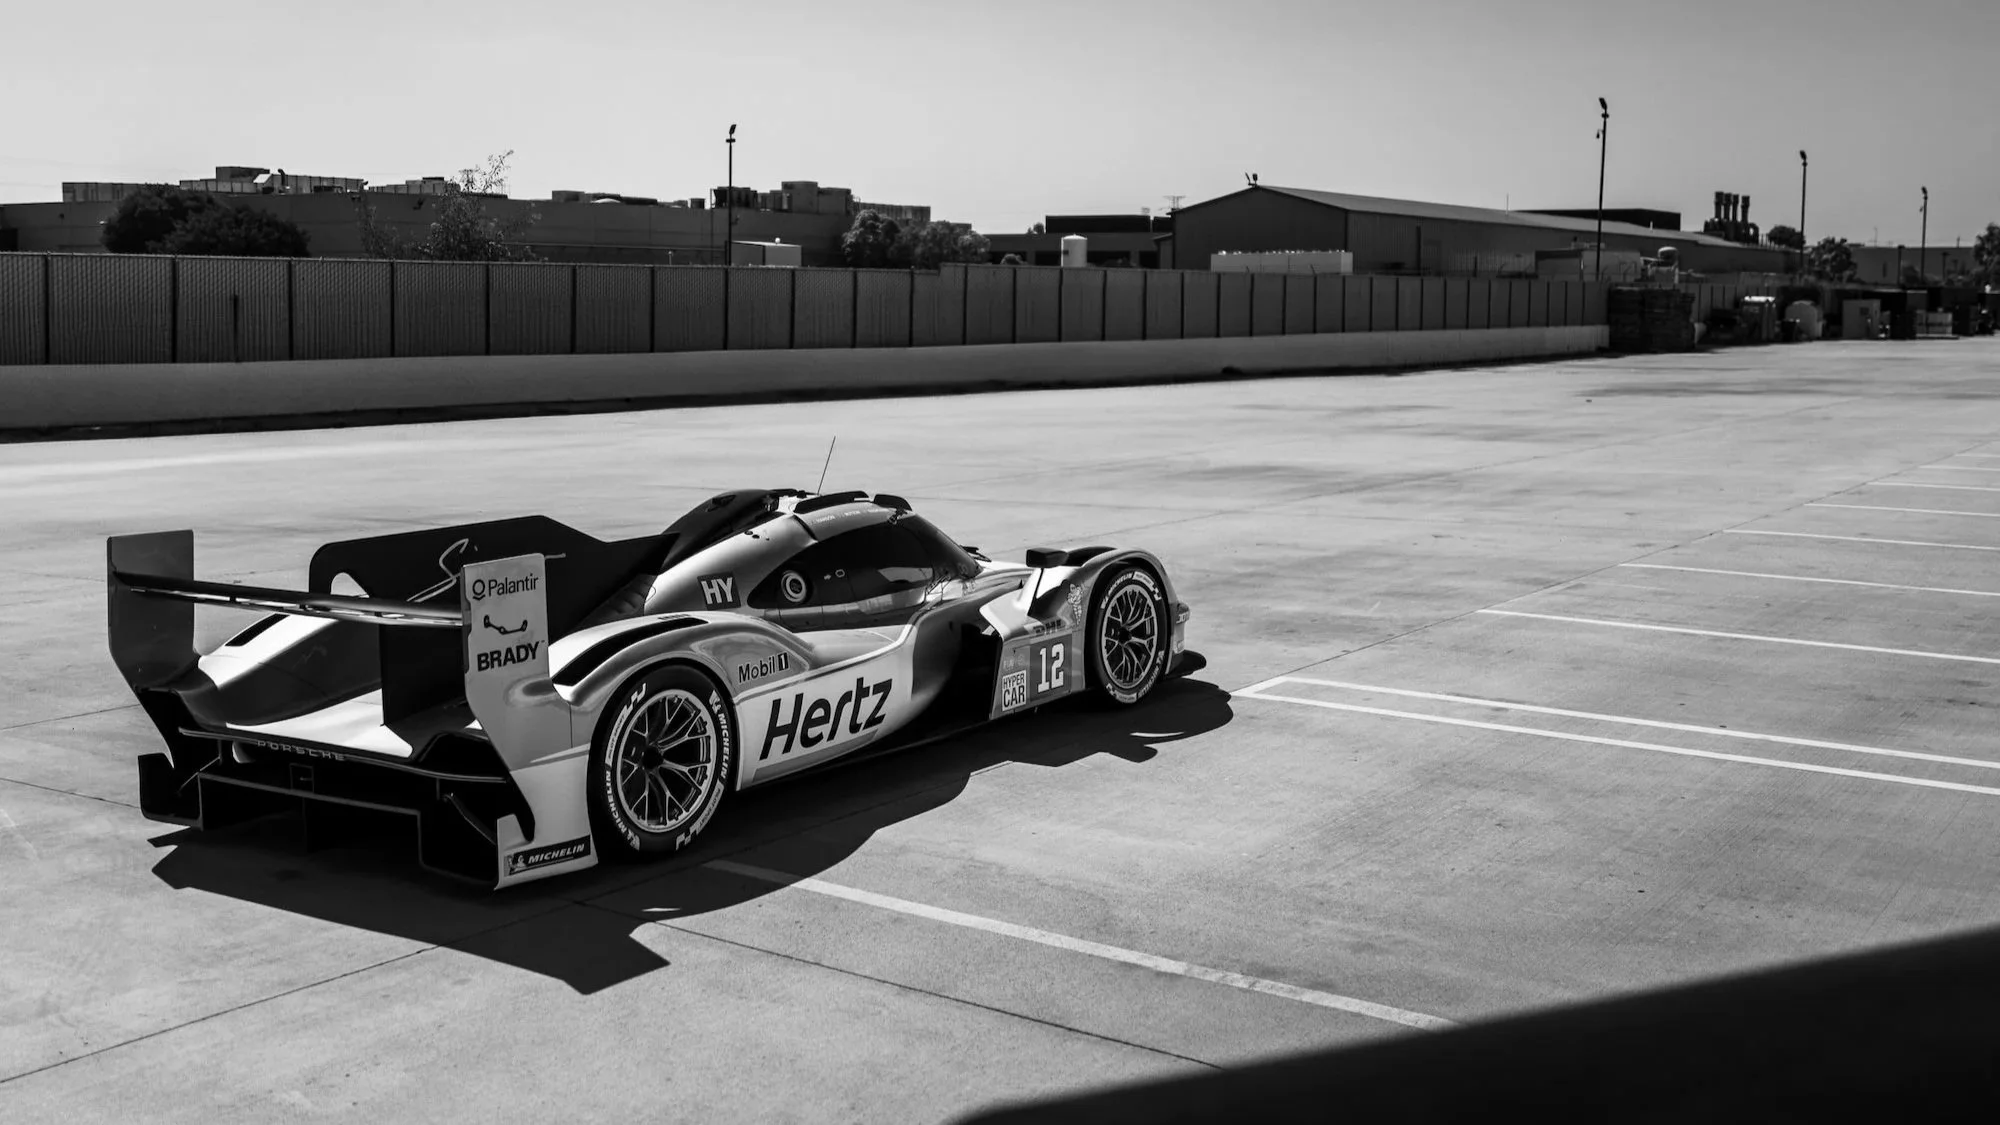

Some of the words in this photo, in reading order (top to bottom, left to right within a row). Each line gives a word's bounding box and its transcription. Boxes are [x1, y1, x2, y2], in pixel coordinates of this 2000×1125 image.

[488, 573, 539, 597] Palantir
[701, 577, 733, 605] HY
[477, 641, 540, 672] BRADY
[738, 656, 775, 683] Mobil
[778, 652, 789, 671] 1
[1037, 643, 1065, 693] 12
[1003, 673, 1025, 689] HYPER
[1003, 685, 1025, 708] CAR
[759, 677, 893, 761] Hertz
[257, 740, 345, 761] PORSCHE
[717, 713, 731, 779] MICHELIN
[605, 770, 628, 834] MICHELIN
[528, 843, 585, 864] MICHELIN
